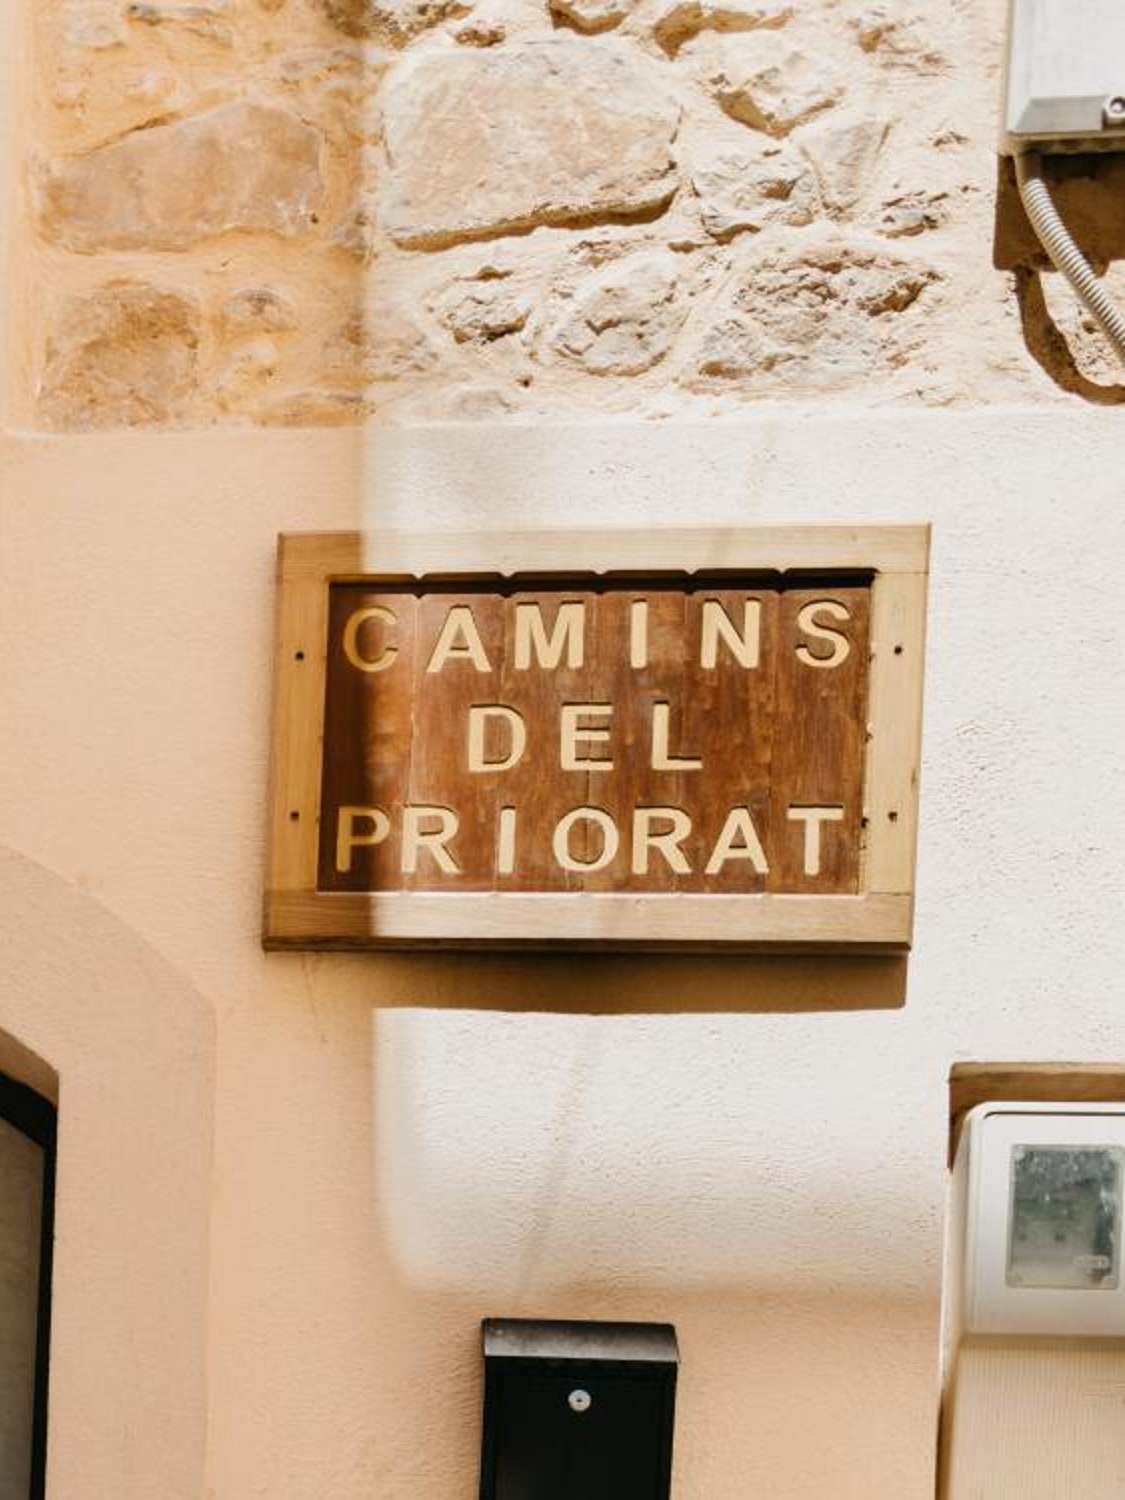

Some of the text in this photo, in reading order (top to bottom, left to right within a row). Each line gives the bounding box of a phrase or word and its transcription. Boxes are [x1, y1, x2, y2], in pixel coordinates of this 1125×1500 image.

[342, 599, 851, 673] CAMINS
[468, 702, 702, 773] DEL
[335, 804, 844, 876] PRIORAT
